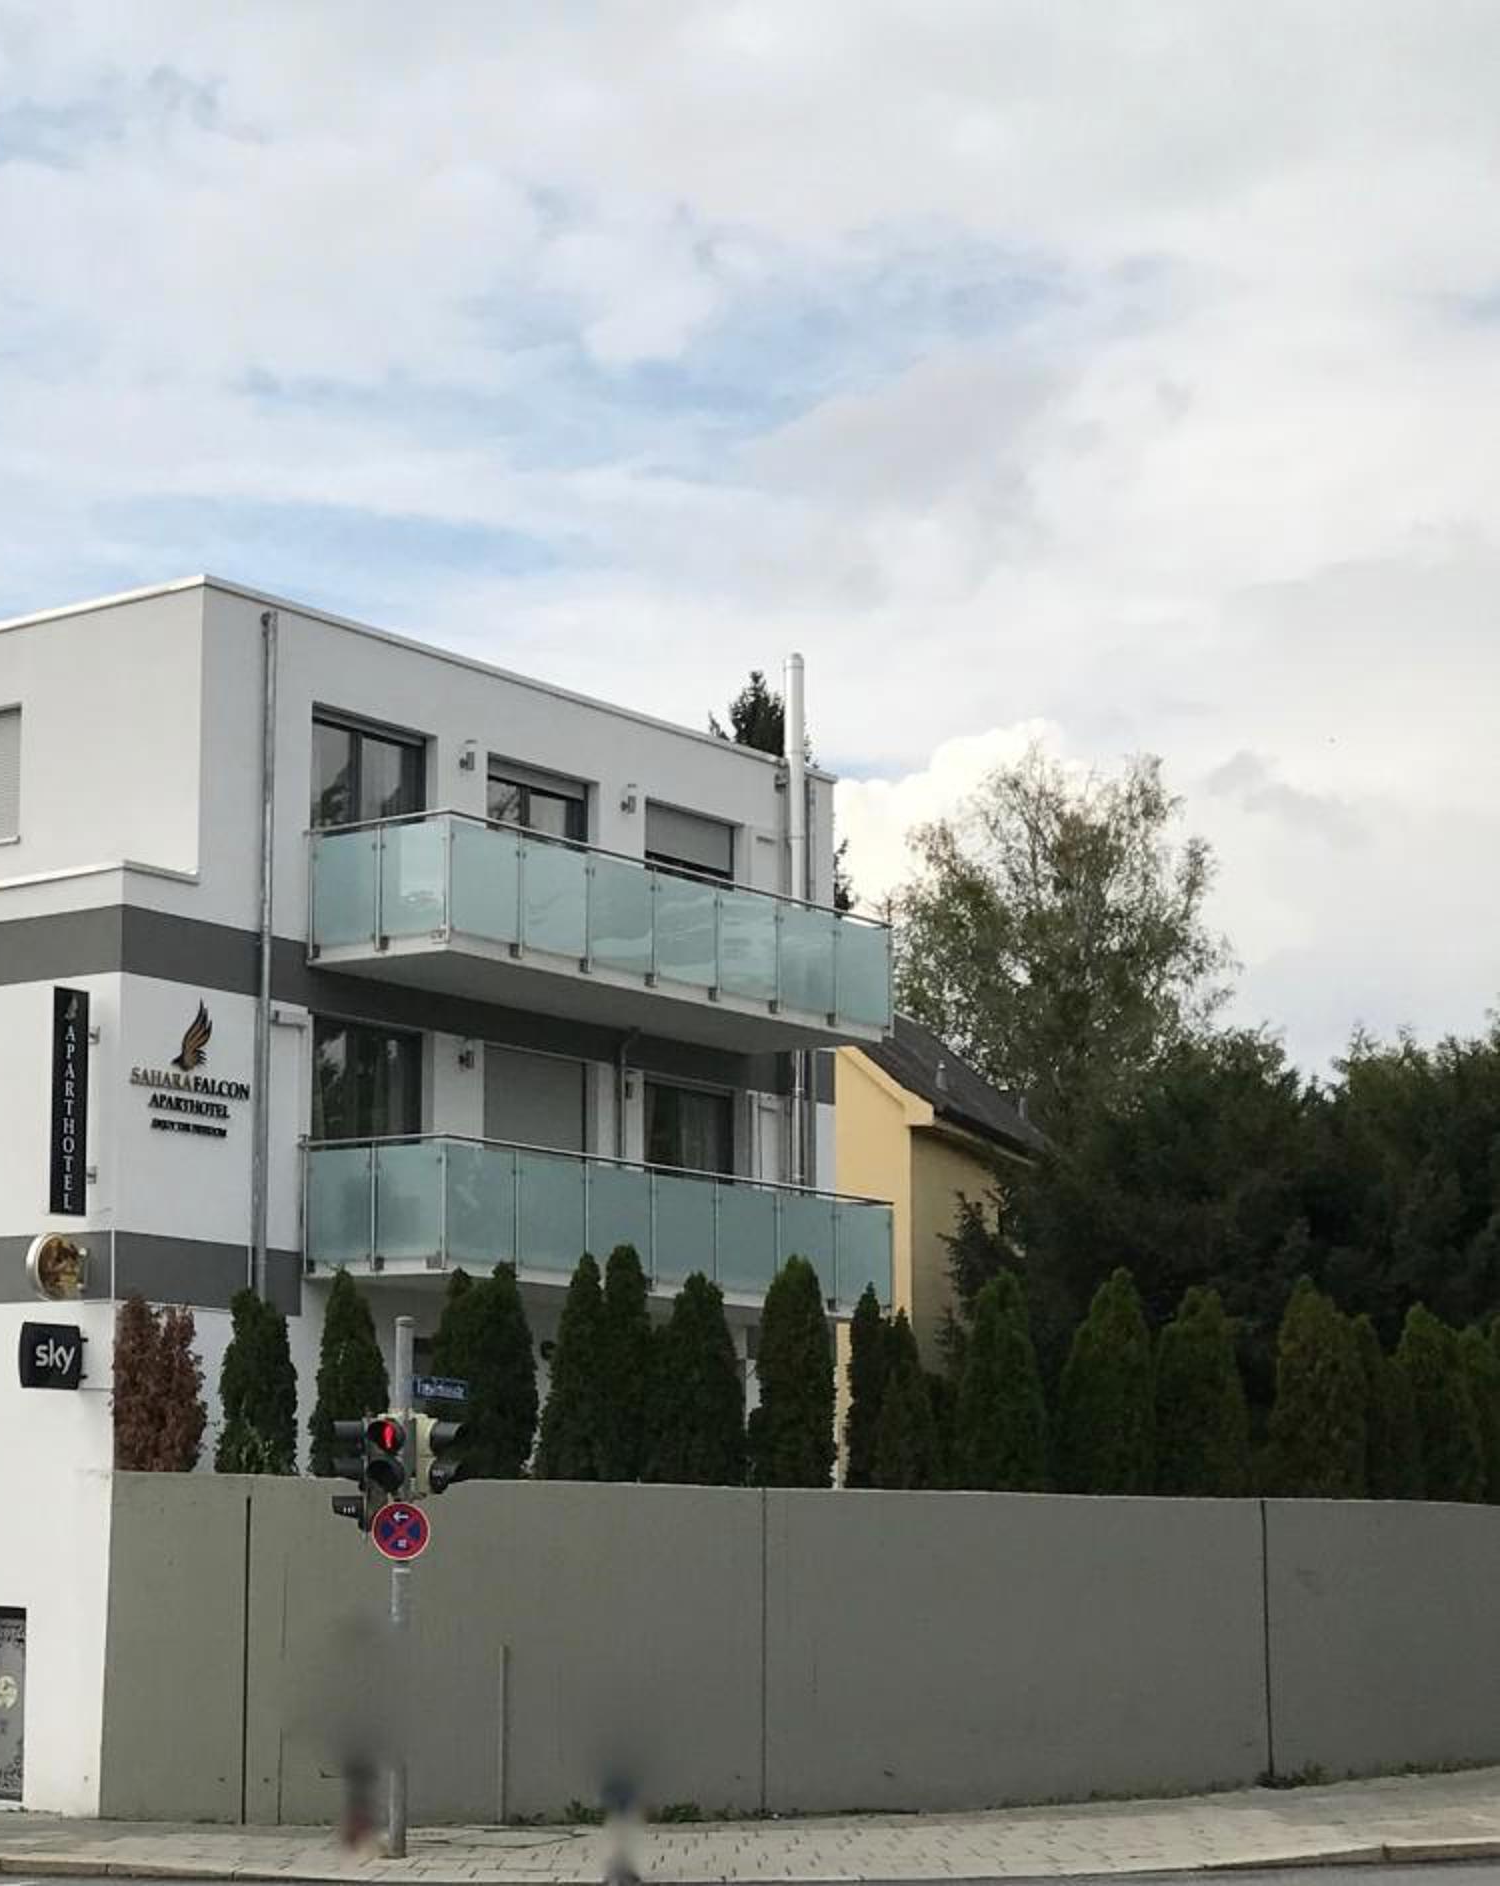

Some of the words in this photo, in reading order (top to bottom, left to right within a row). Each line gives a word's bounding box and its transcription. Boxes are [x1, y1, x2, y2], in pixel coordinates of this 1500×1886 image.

[130, 1067, 191, 1091] SAHARA
[193, 1077, 250, 1101] FALCON
[61, 1025, 76, 1210] APARTHOTEL
[149, 1094, 230, 1119] APARTHOTEL
[35, 1341, 76, 1375] sky
